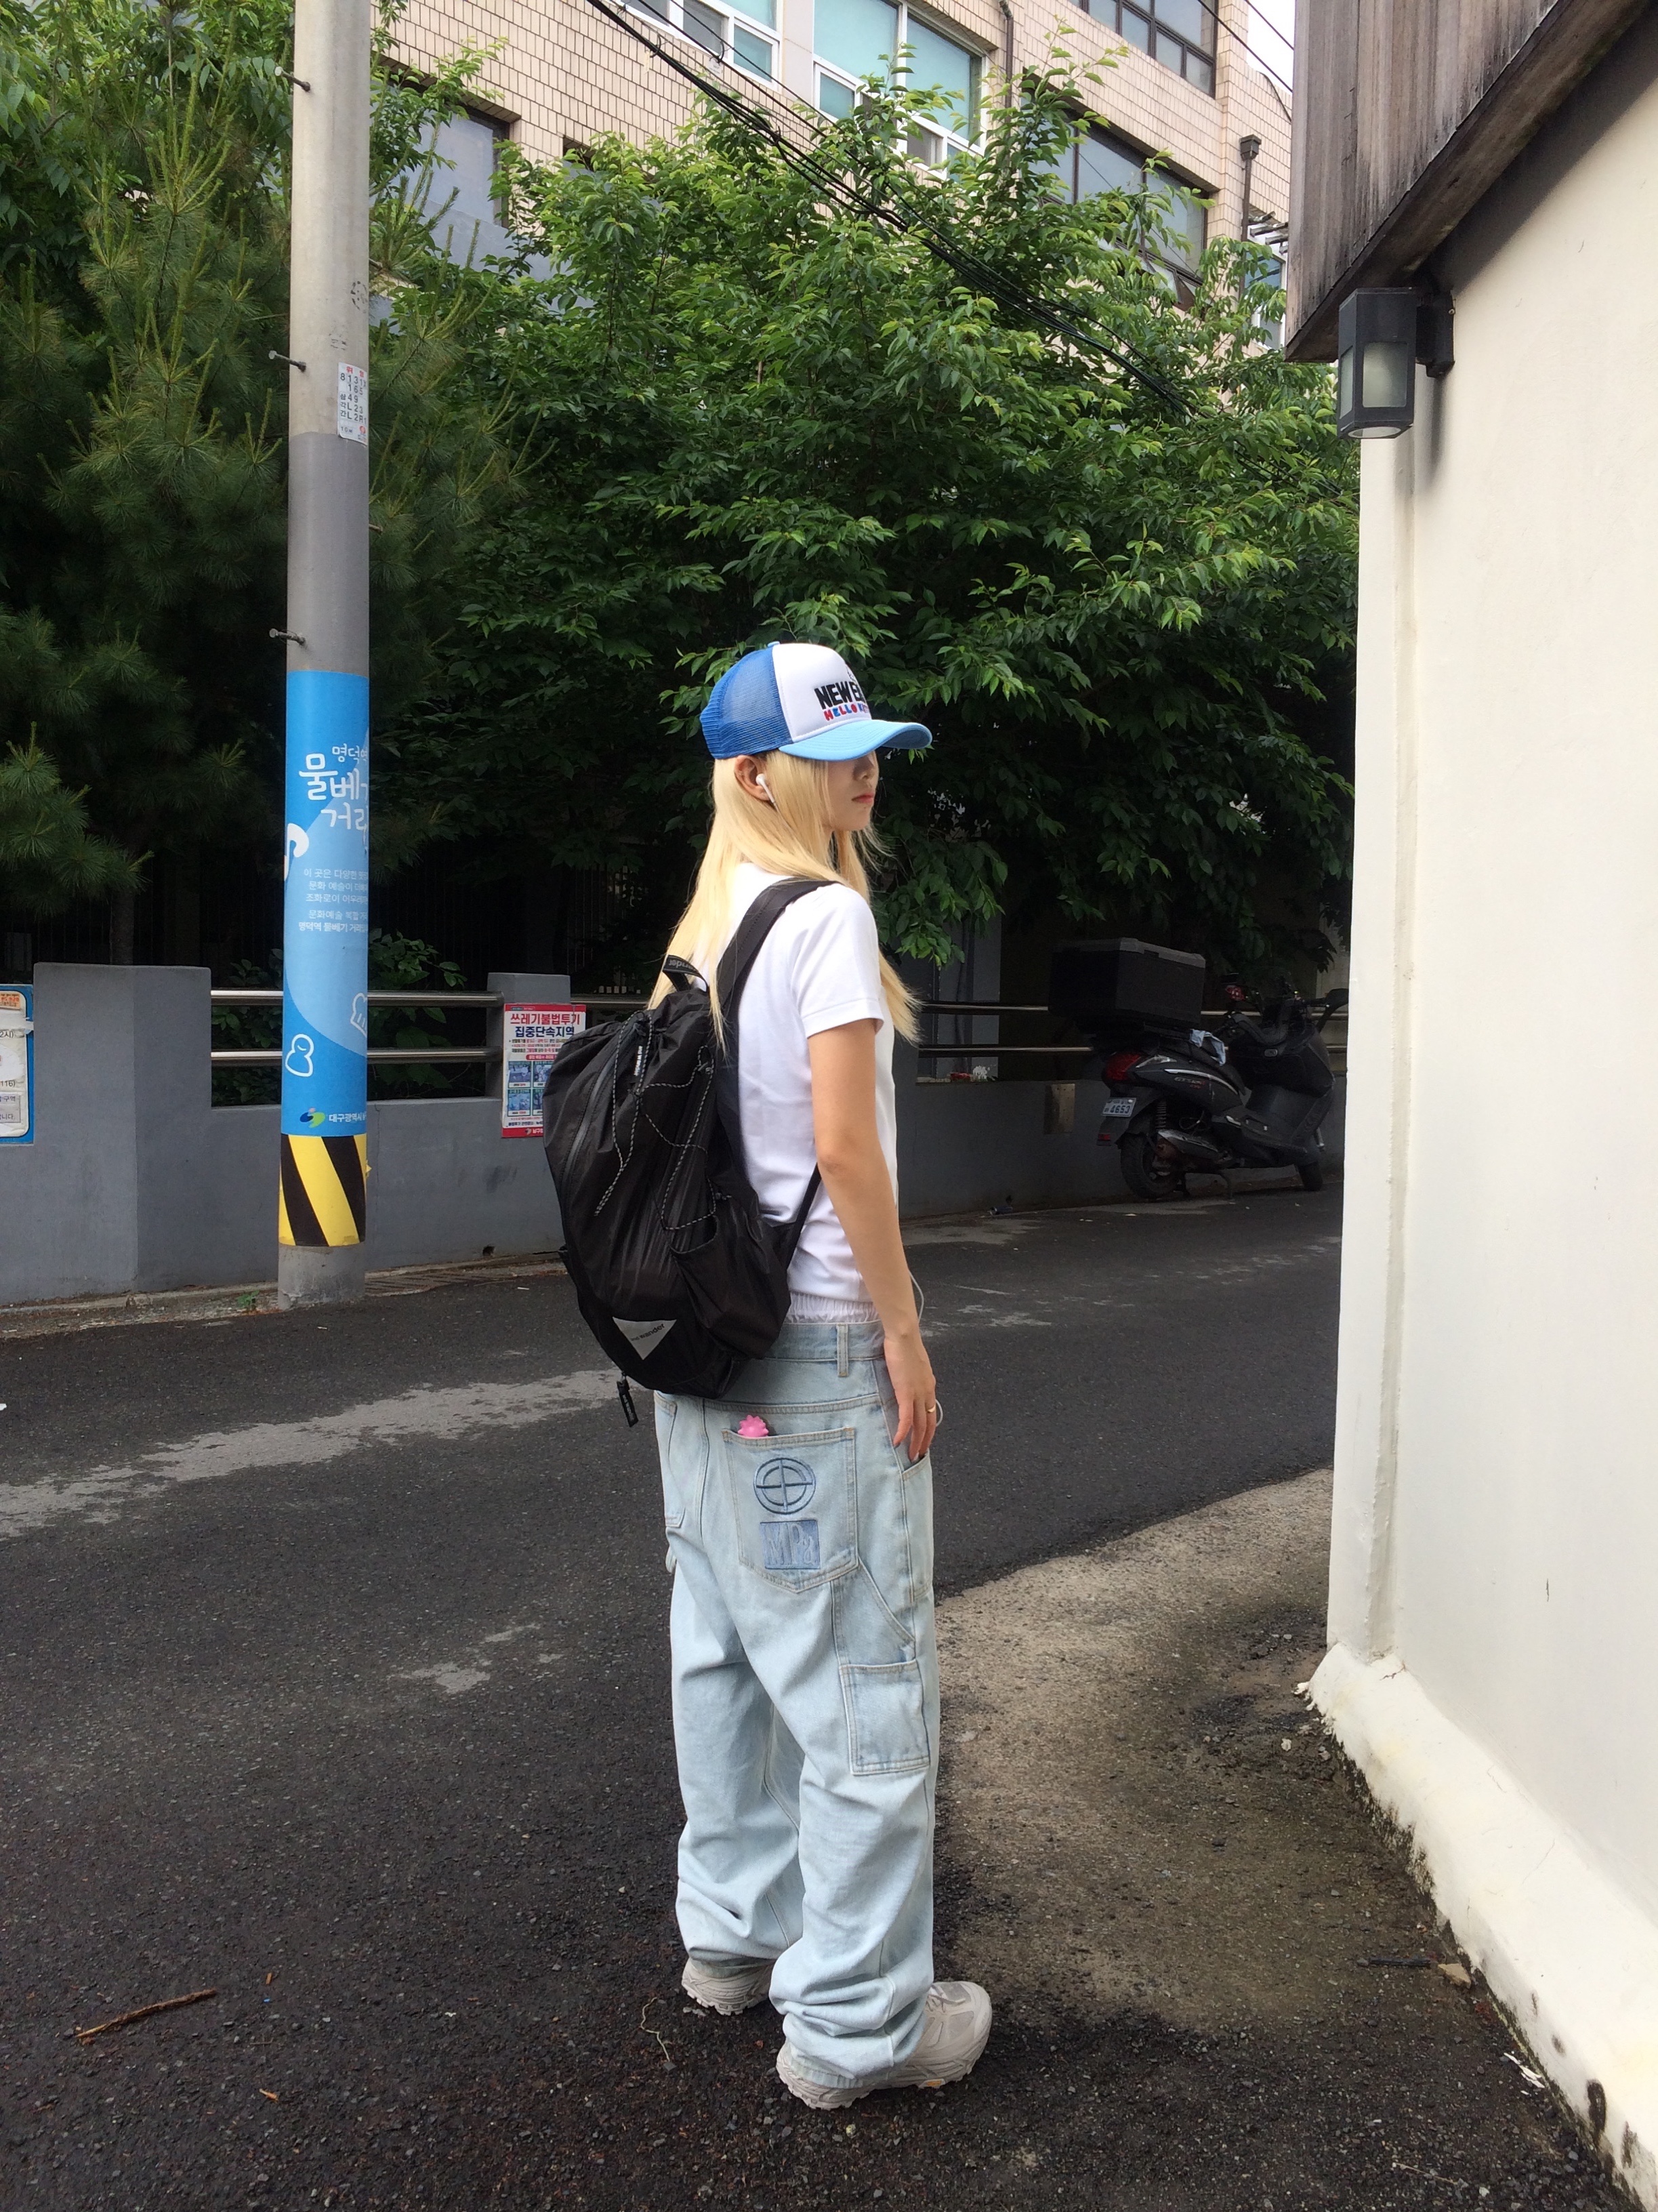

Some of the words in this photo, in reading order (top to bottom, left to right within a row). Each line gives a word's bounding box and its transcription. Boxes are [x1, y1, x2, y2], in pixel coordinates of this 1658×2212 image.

[824, 703, 858, 721] HELLO
[304, 868, 312, 878] 이
[314, 869, 331, 878] 곳은
[309, 881, 326, 890] 문화
[328, 882, 352, 891] 예술이
[306, 893, 339, 903] 조화로이
[299, 922, 321, 931] 명덕역
[324, 922, 348, 933] 물베기
[515, 1026, 575, 1038] 집중단속지역
[640, 1324, 665, 1338] wander
